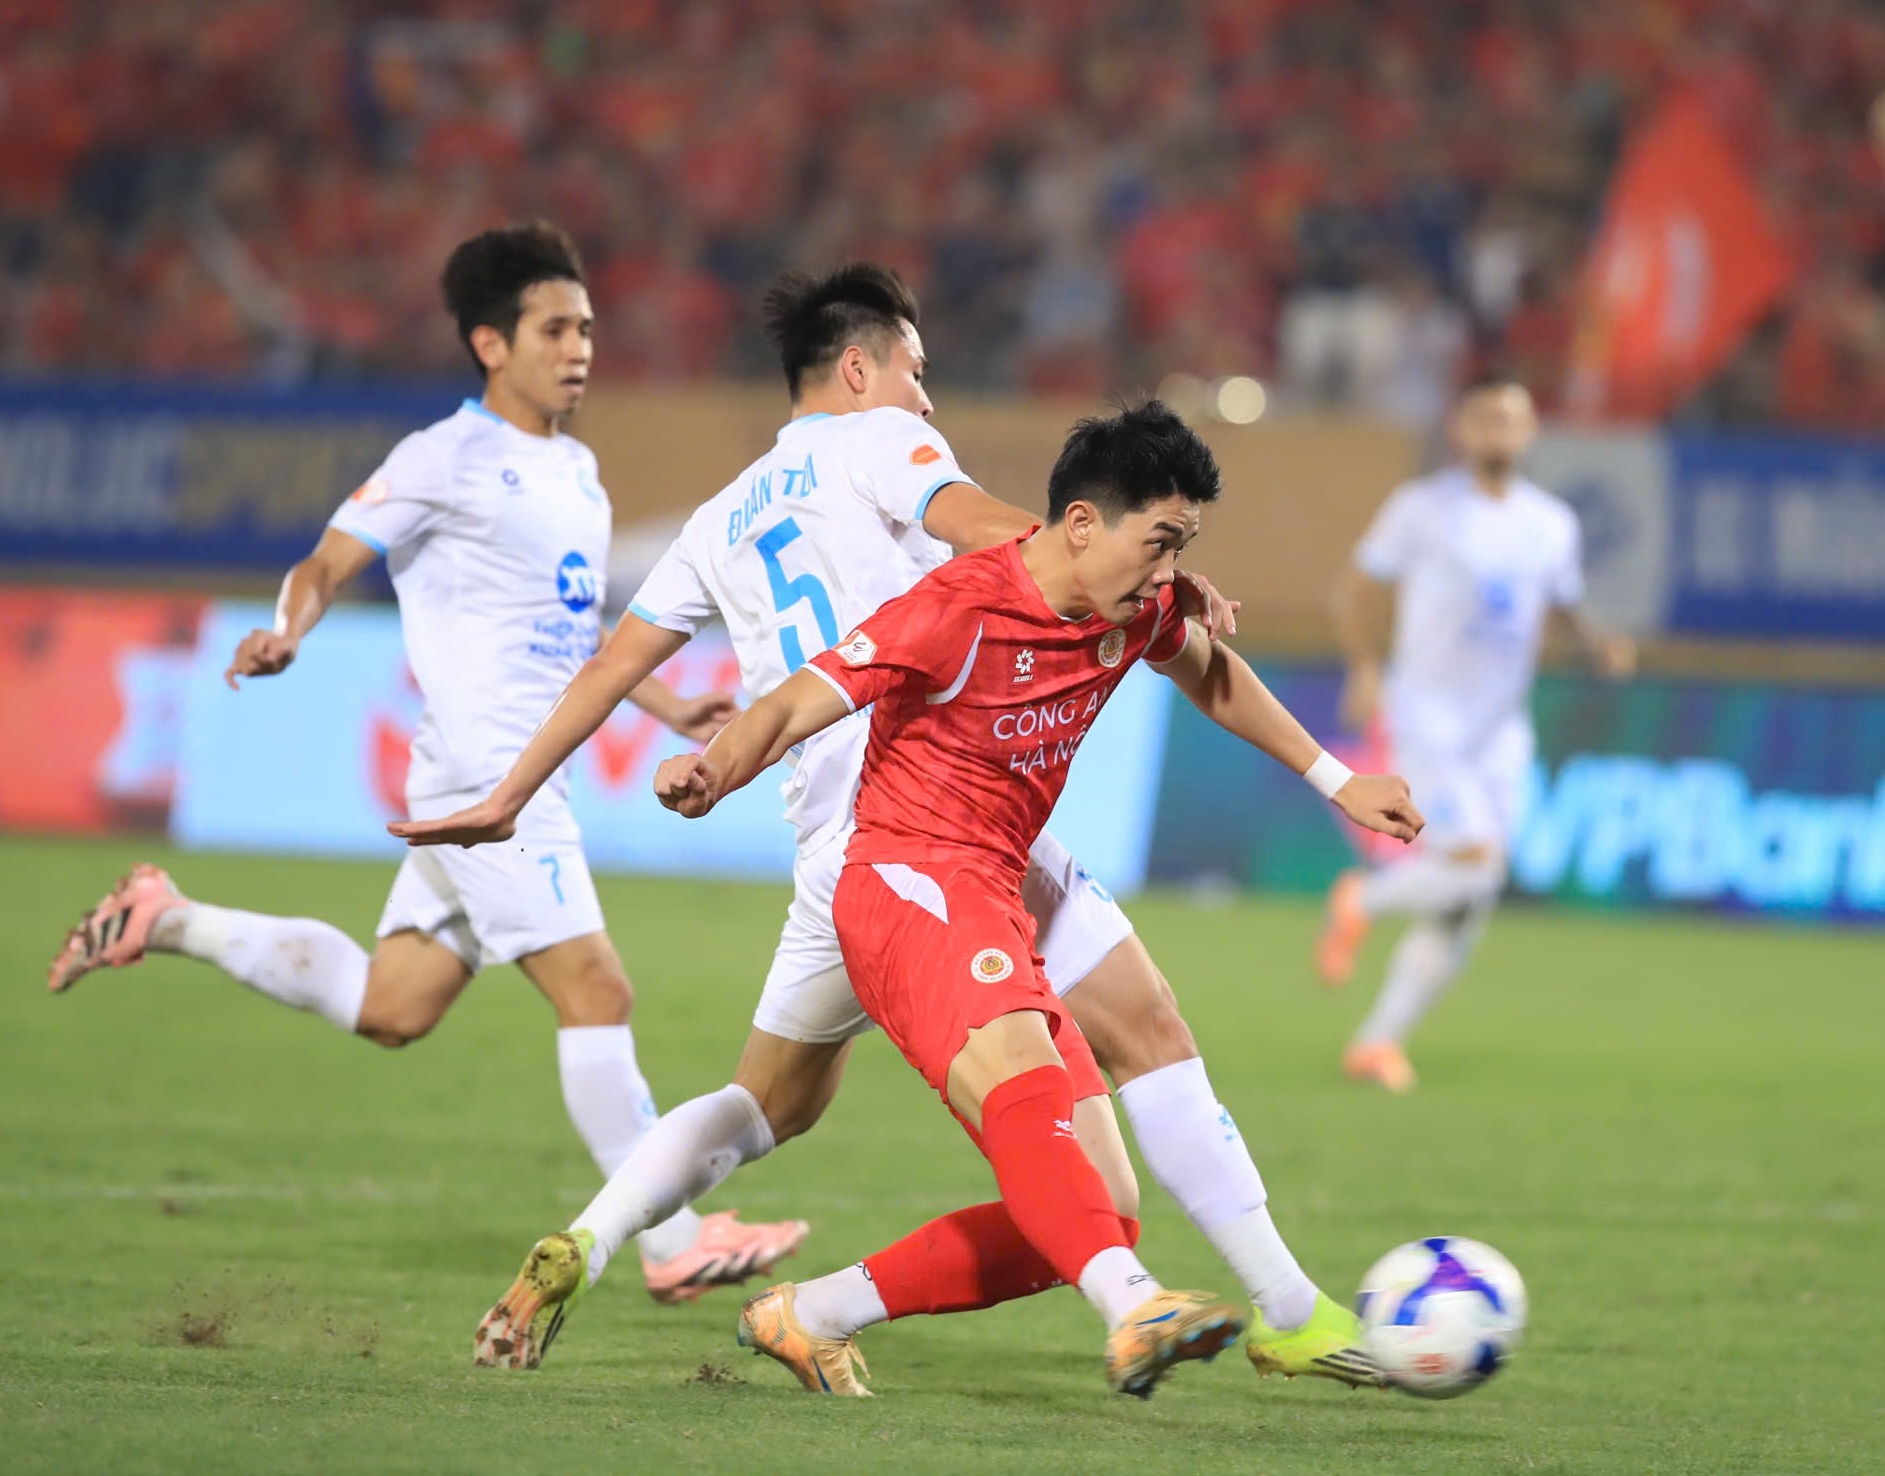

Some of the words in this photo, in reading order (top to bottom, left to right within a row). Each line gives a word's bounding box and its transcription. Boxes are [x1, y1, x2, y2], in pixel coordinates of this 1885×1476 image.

[754, 516, 840, 675] 5
[993, 699, 1077, 740] CÔNG
[1009, 739, 1047, 775] HÀ
[1053, 724, 1087, 766] NÔ
[1508, 752, 1885, 910] VPBan
[538, 854, 566, 906] 7
